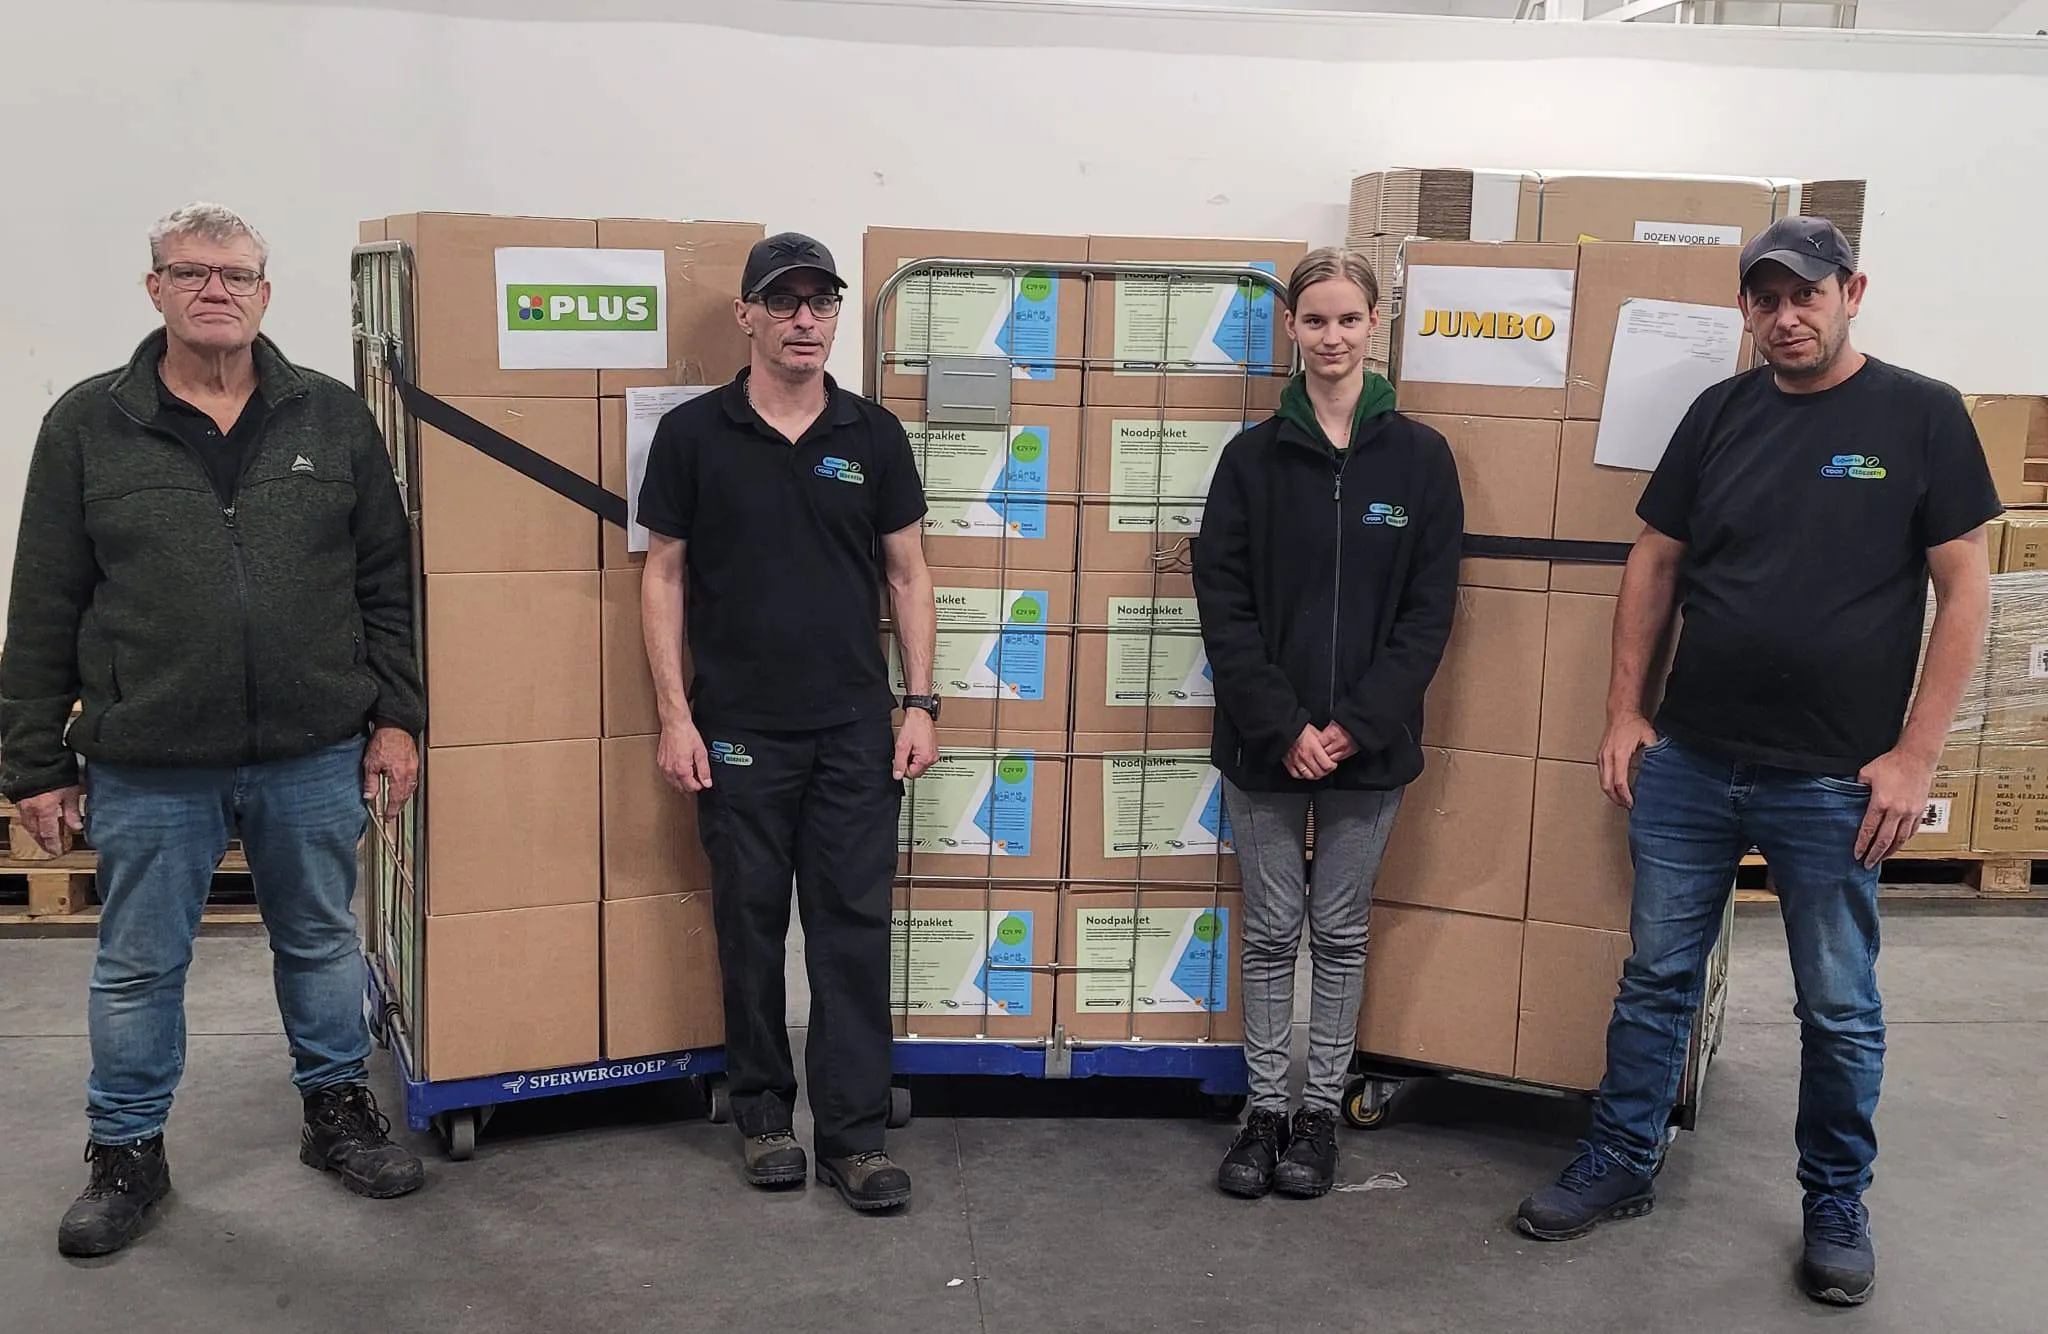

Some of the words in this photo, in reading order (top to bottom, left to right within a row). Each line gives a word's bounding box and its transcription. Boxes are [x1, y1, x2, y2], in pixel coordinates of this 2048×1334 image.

[1643, 232, 1676, 241] DOZEN
[1679, 235, 1705, 244] VOOR
[1707, 236, 1720, 245] DE
[550, 295, 649, 321] PLUS
[1418, 310, 1555, 341] JUMBO
[529, 1059, 666, 1089] SPERWERGROEP
